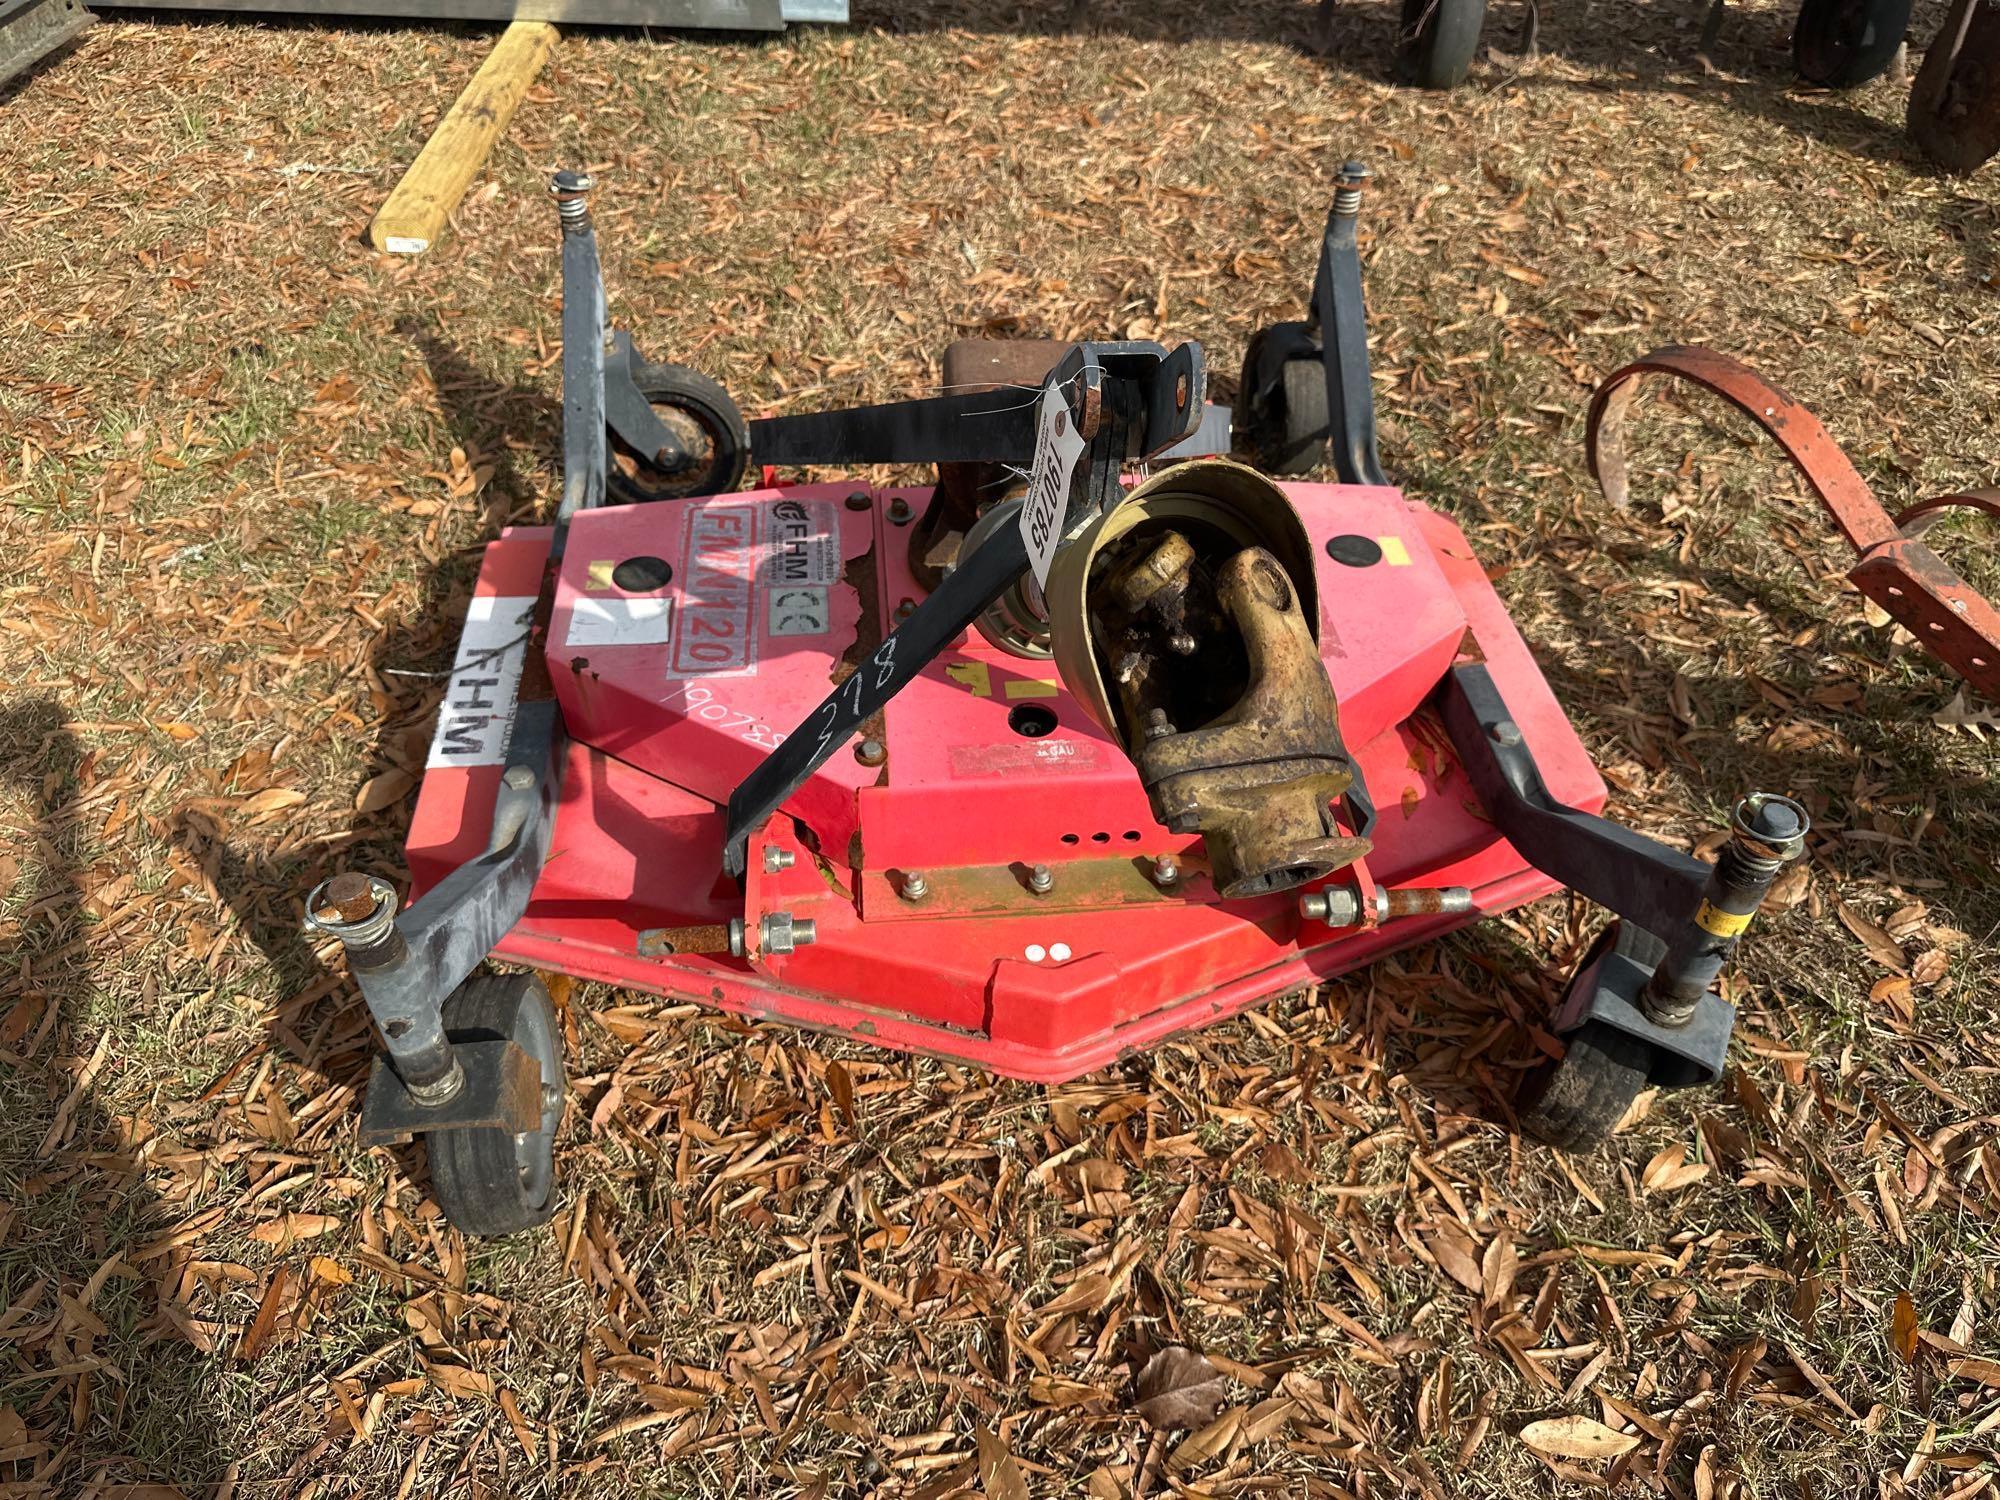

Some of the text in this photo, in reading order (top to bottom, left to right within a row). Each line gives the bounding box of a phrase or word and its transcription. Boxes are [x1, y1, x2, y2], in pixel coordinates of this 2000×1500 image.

[786, 523, 808, 580] FHM
[1031, 441, 1064, 560] 190785
[441, 648, 506, 755] FHM
